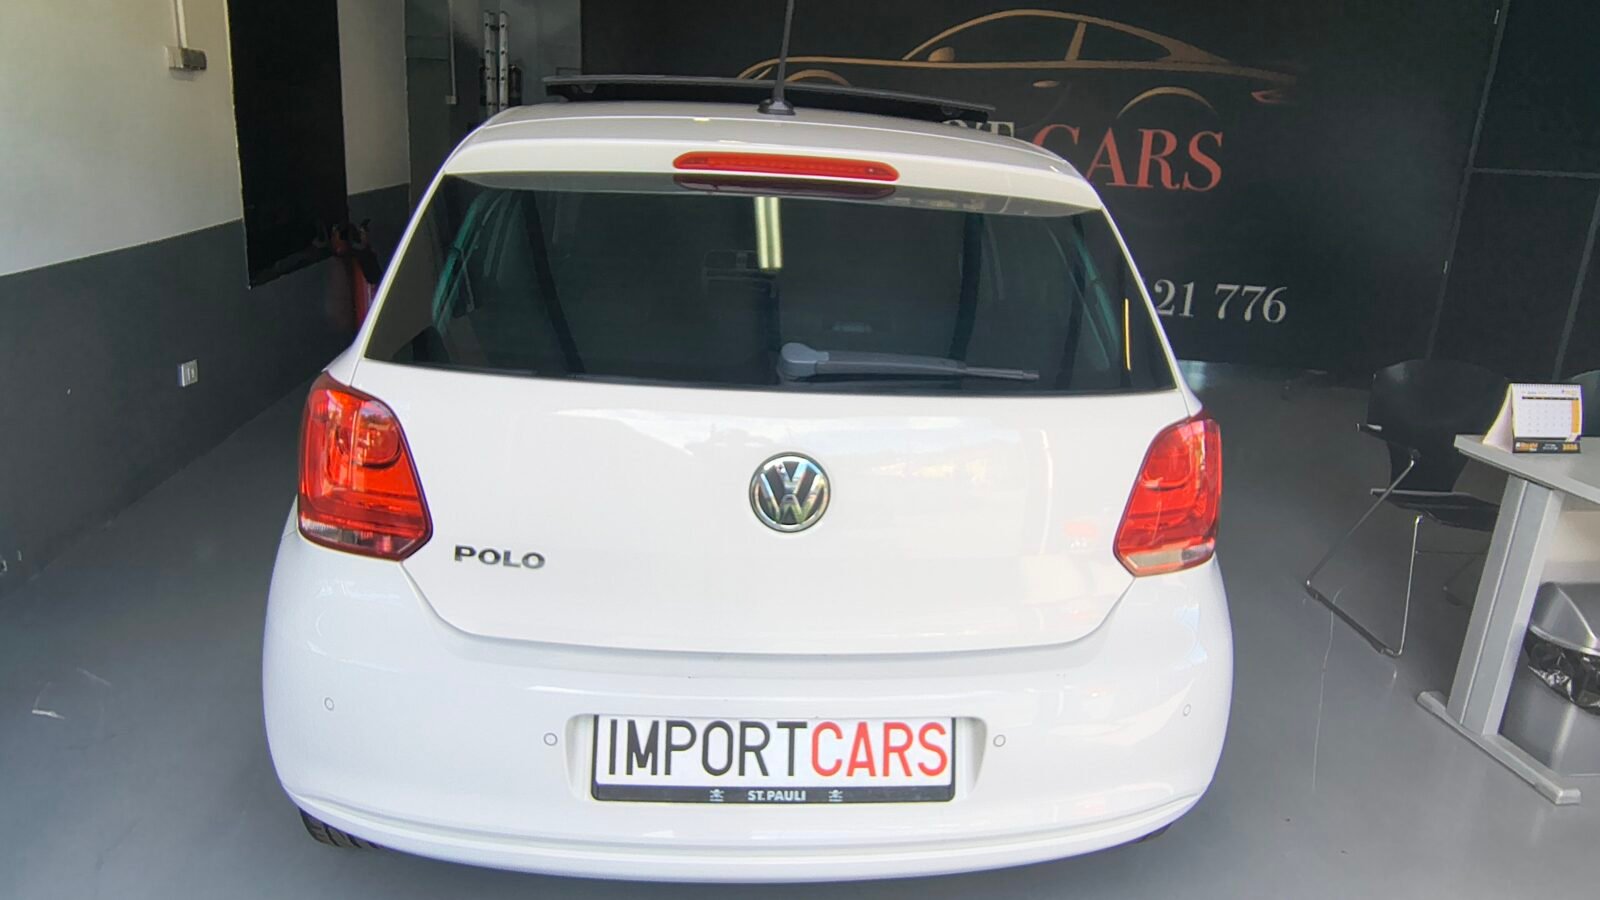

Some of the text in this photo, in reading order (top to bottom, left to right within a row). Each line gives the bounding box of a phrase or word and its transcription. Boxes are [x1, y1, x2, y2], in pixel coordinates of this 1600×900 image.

[1150, 279, 1288, 323] 21 776
[454, 545, 546, 569] POLO
[608, 719, 949, 777] IMPORTCARS
